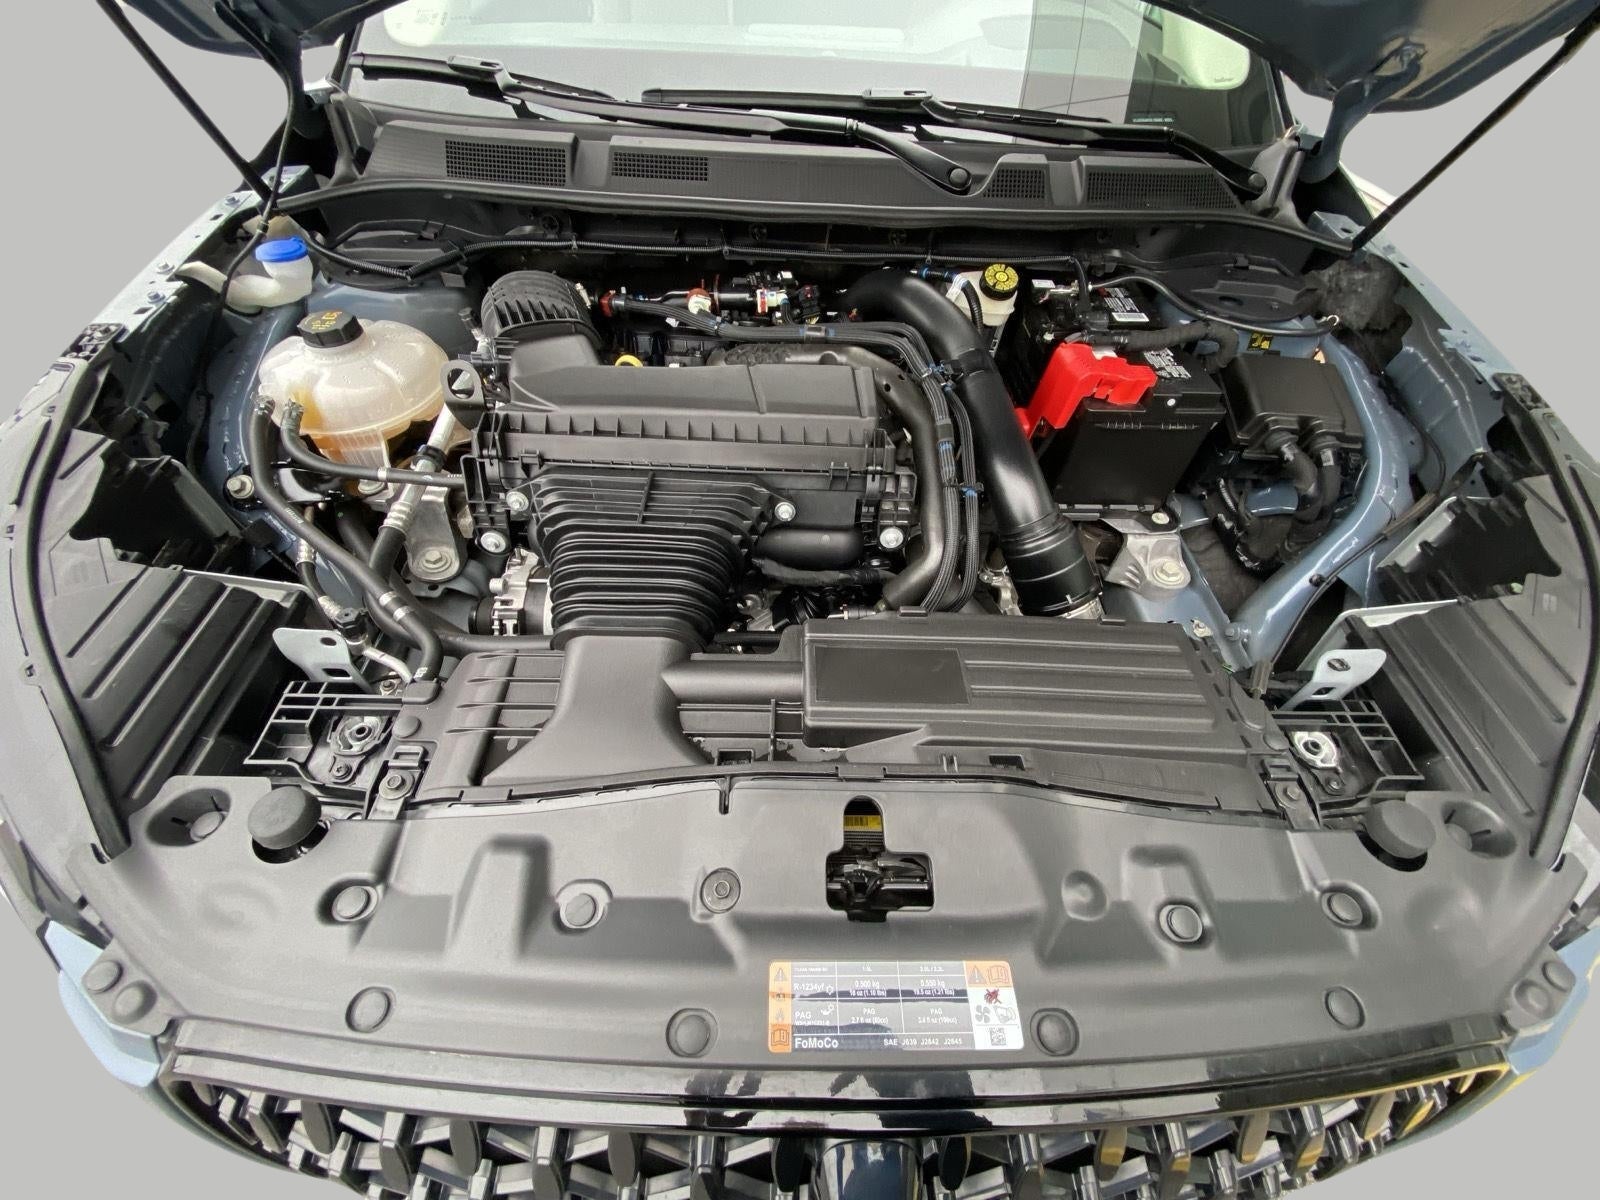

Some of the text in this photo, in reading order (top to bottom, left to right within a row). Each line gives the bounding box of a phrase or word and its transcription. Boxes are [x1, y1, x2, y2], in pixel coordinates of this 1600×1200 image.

[793, 982, 825, 992] R-1234yf
[794, 1011, 812, 1019] PAG
[795, 1036, 839, 1048] FoMoCo
